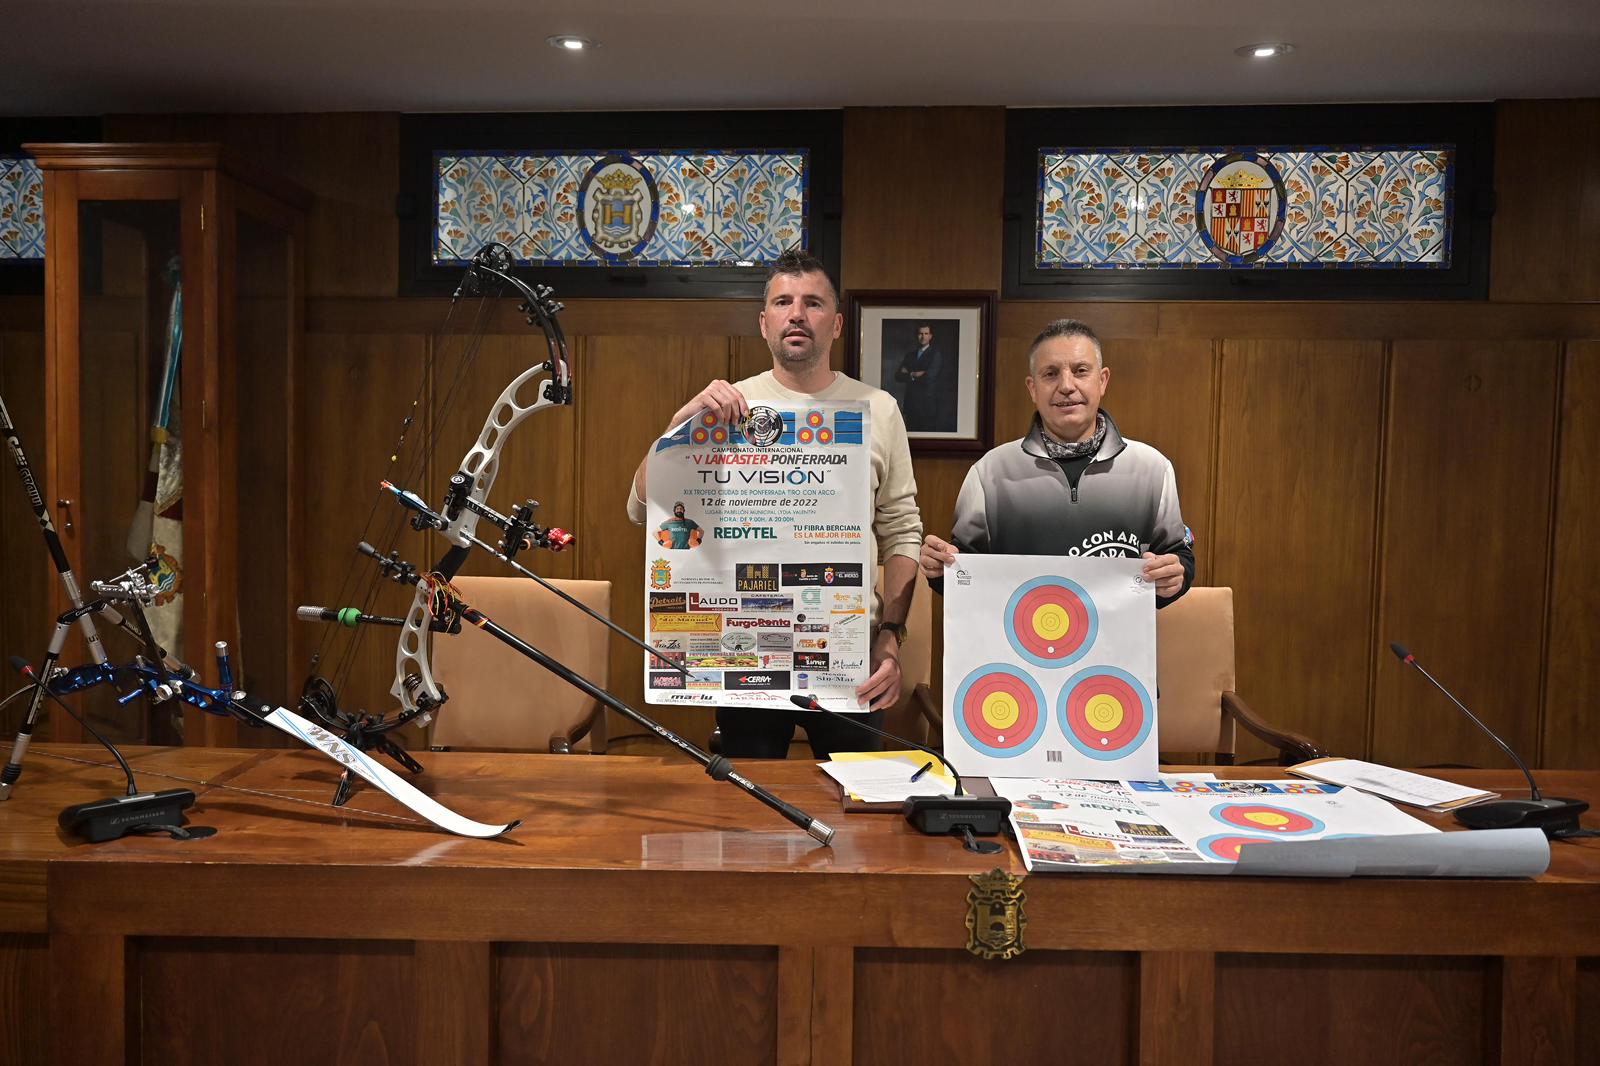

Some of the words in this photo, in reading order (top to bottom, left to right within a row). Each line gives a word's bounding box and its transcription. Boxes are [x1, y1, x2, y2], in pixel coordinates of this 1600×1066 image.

[697, 470, 730, 484] TU
[701, 498, 714, 507] 12
[715, 498, 726, 507] de
[728, 498, 777, 507] noviembre
[780, 498, 791, 507] de
[793, 499, 818, 507] 2022
[714, 526, 778, 539] REDYTEL
[1082, 530, 1114, 549] CON
[738, 580, 777, 591] PAJARIEL
[690, 596, 738, 605] LAUDO
[726, 618, 791, 629] FurgoRenta
[1095, 788, 1132, 796] VIS
[1080, 803, 1147, 816] REDYTE
